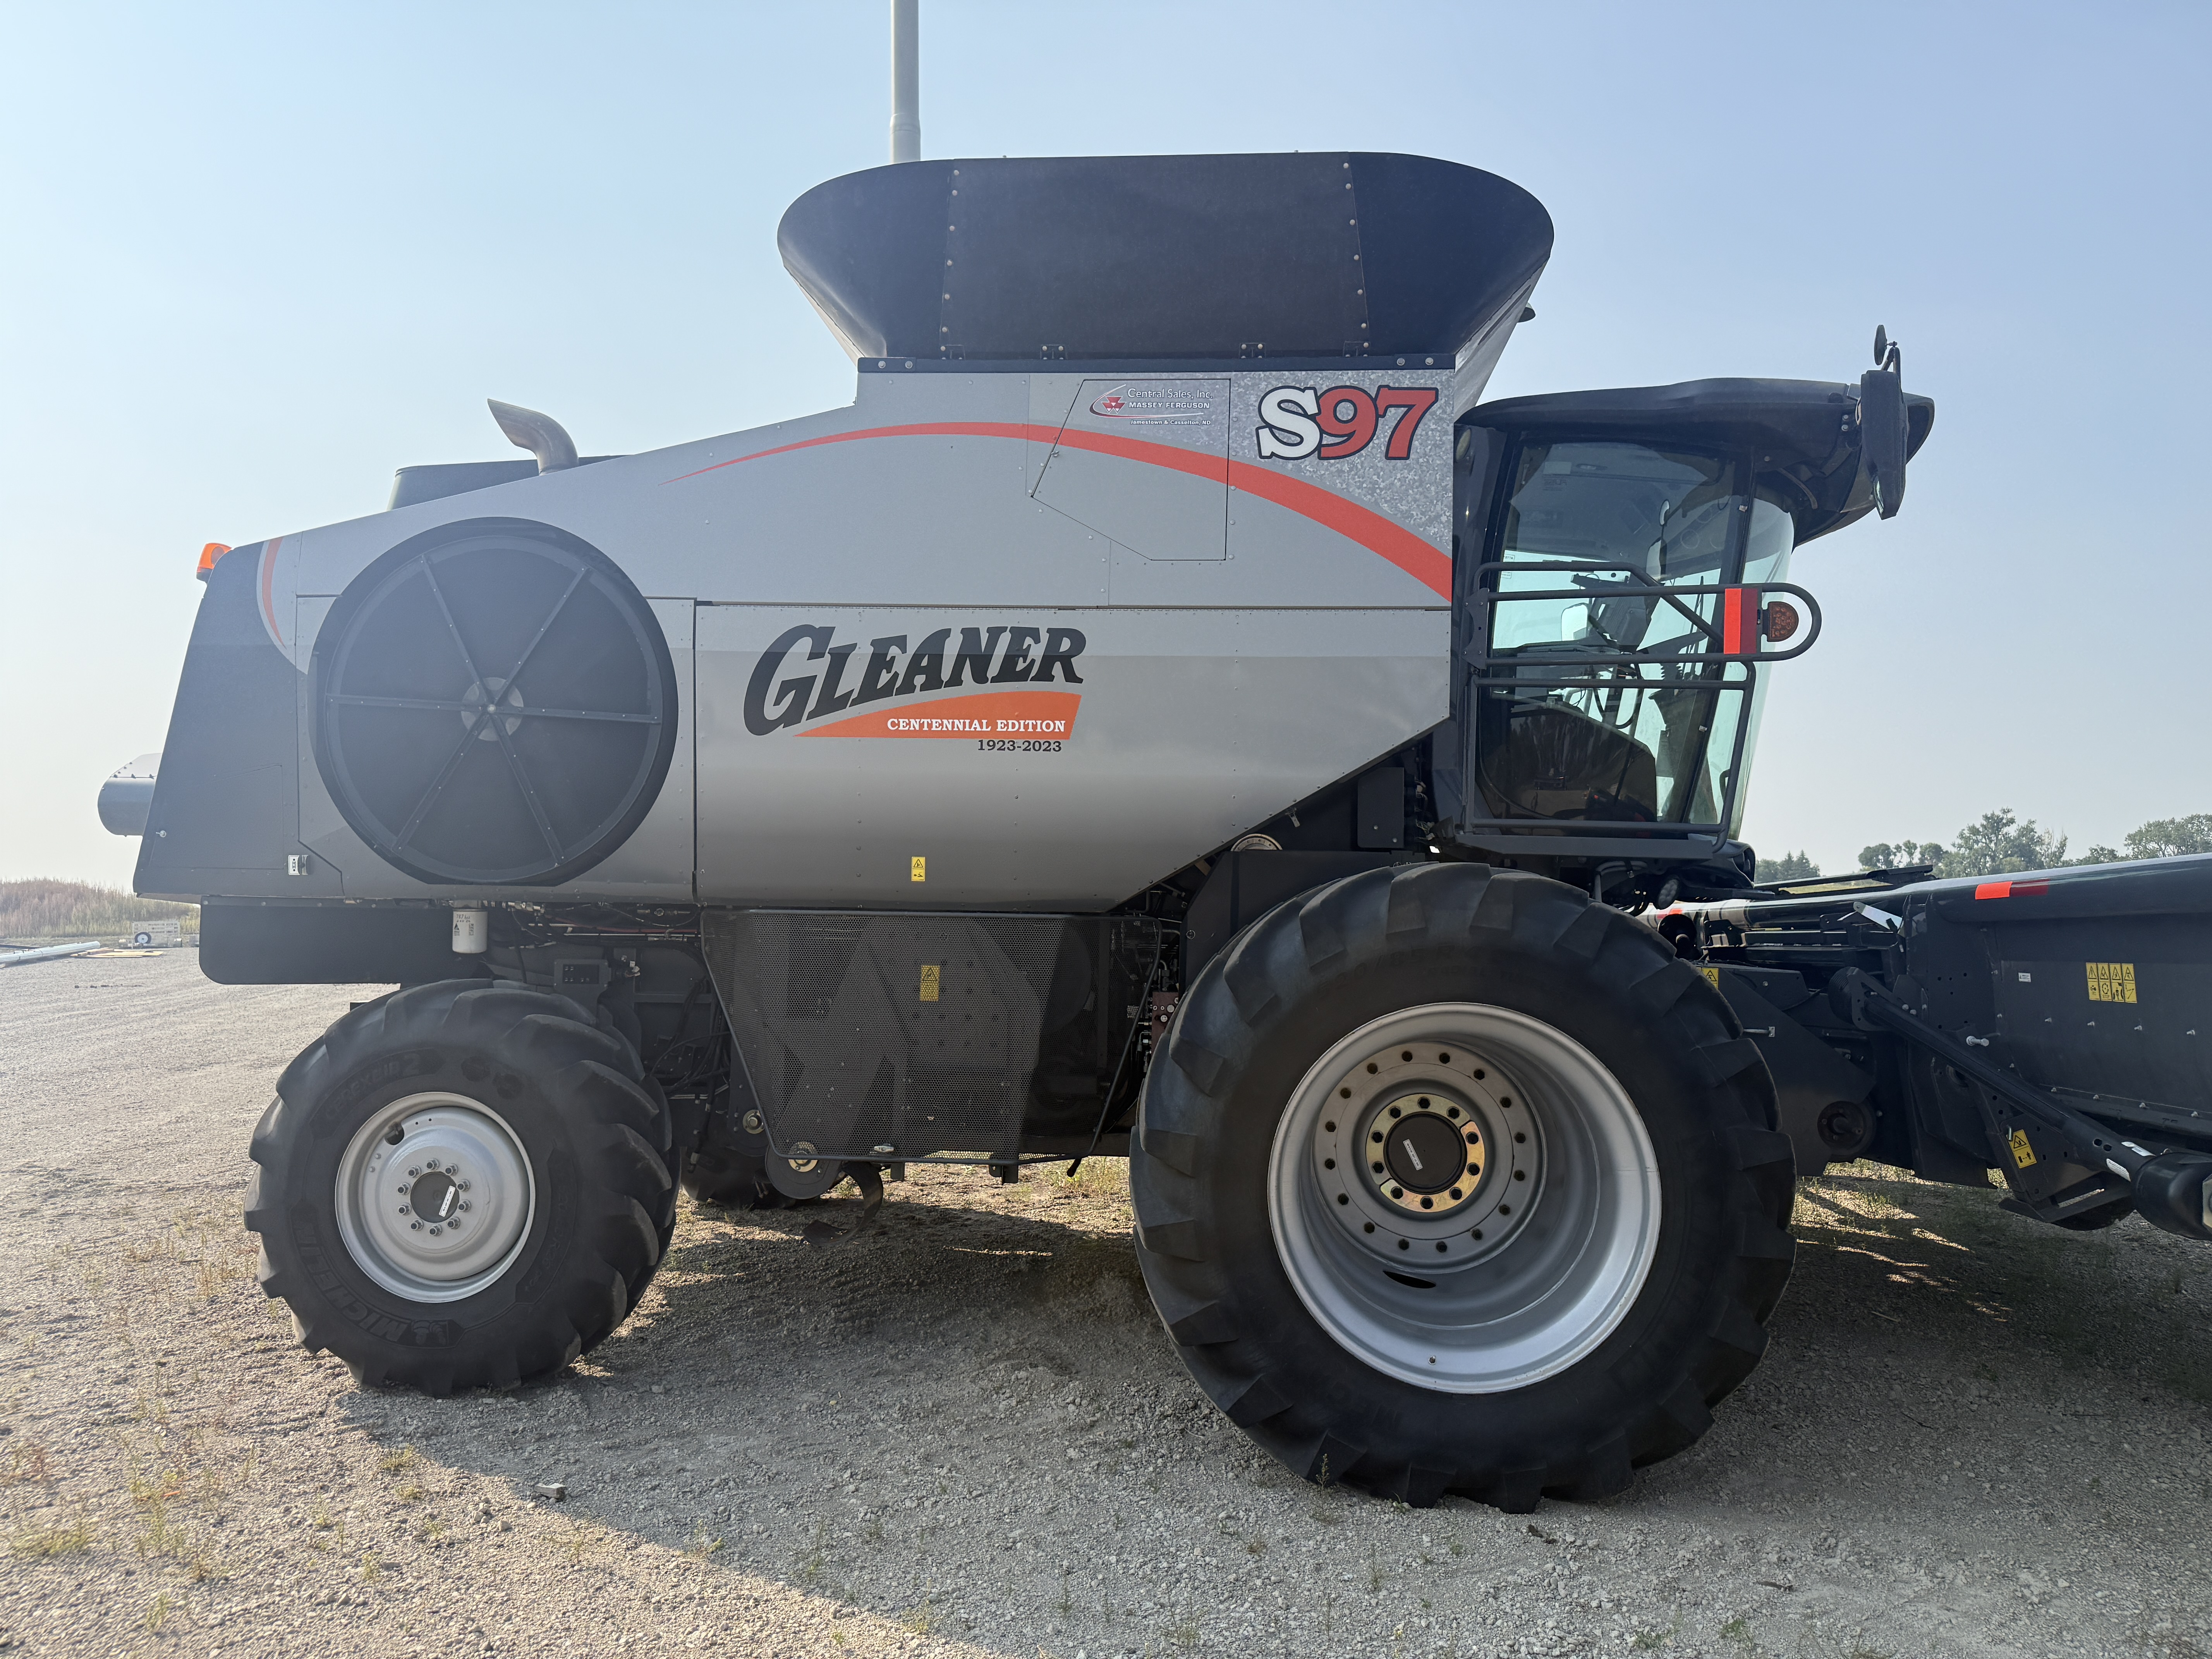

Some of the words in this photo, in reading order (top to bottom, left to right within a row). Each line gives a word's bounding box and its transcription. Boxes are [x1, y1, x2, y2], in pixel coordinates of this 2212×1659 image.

[1127, 388, 1164, 398] Central
[1167, 389, 1194, 400] Sales,
[1197, 389, 1213, 398] Inc.
[1256, 385, 1438, 460] S97
[744, 624, 1086, 736] GLEANER
[887, 718, 991, 732] CENTENNIAL
[996, 720, 1065, 732] EDITION
[977, 739, 1062, 752] 1923-2023
[402, 1053, 422, 1077] 2
[294, 1218, 408, 1343] MICHELIN
